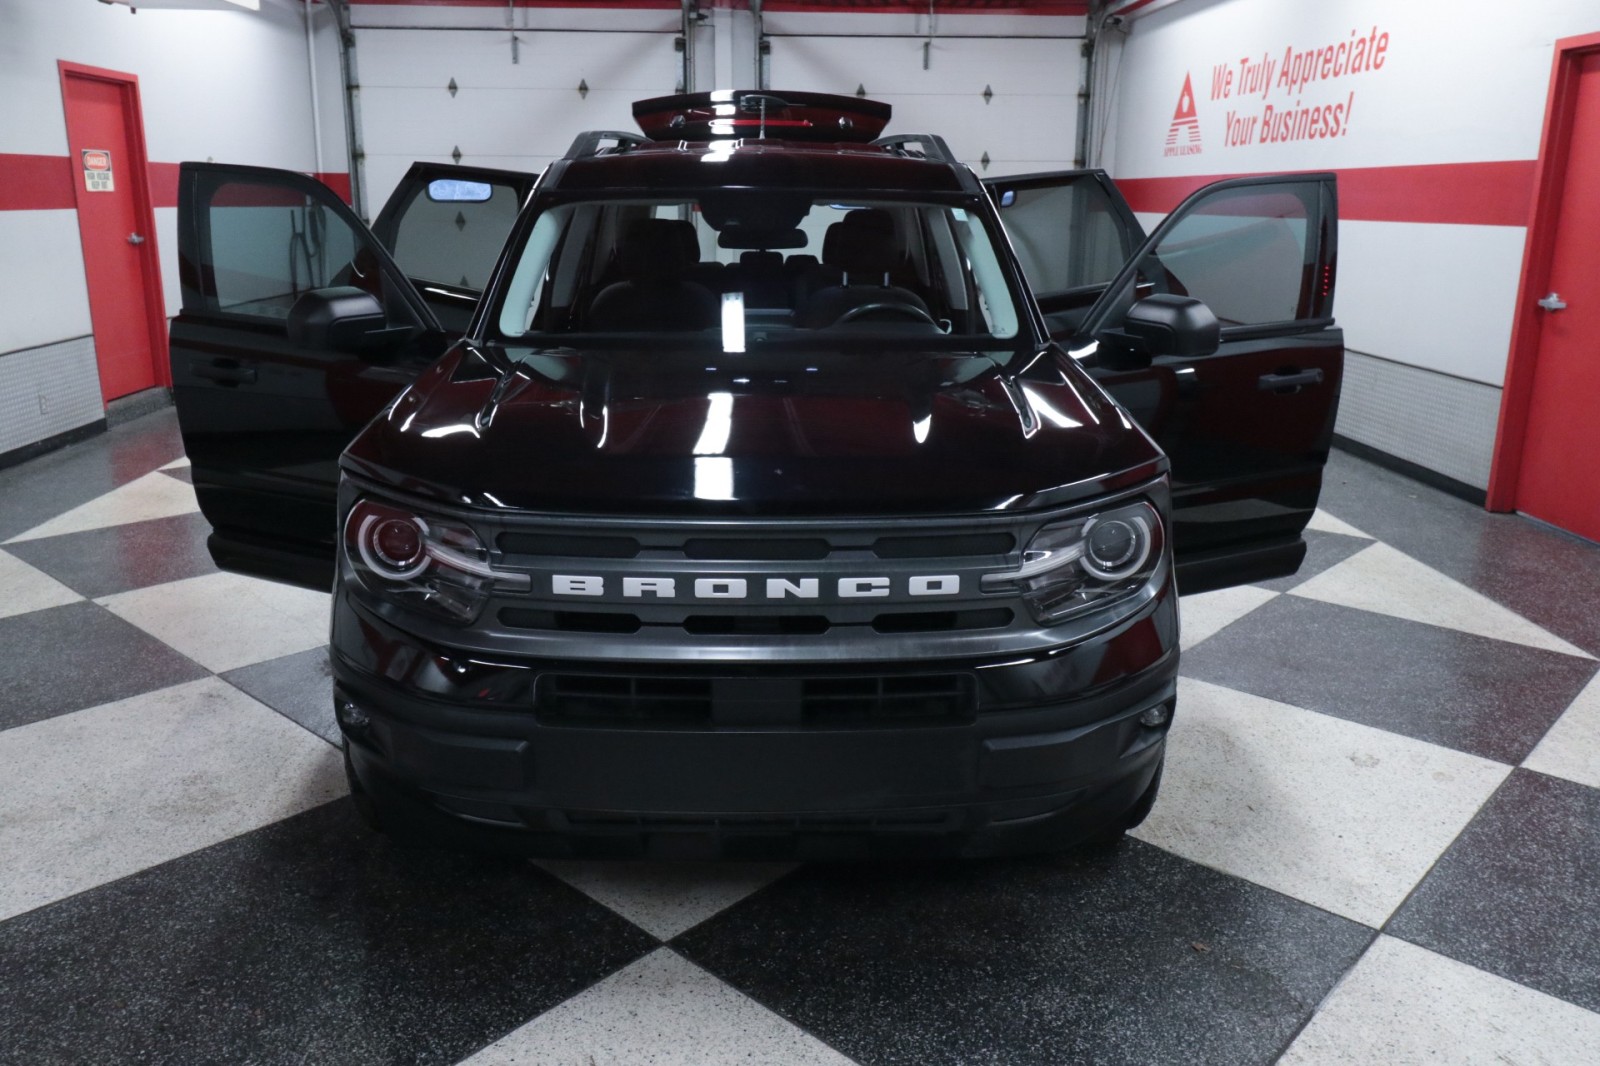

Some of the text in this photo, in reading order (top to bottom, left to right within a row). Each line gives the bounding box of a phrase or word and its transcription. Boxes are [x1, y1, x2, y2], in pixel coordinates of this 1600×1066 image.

[1211, 26, 1389, 100] We Truly Appreciate
[1224, 91, 1354, 147] Your Business!
[86, 155, 107, 166] DANGER
[552, 574, 961, 599] BRONCO
